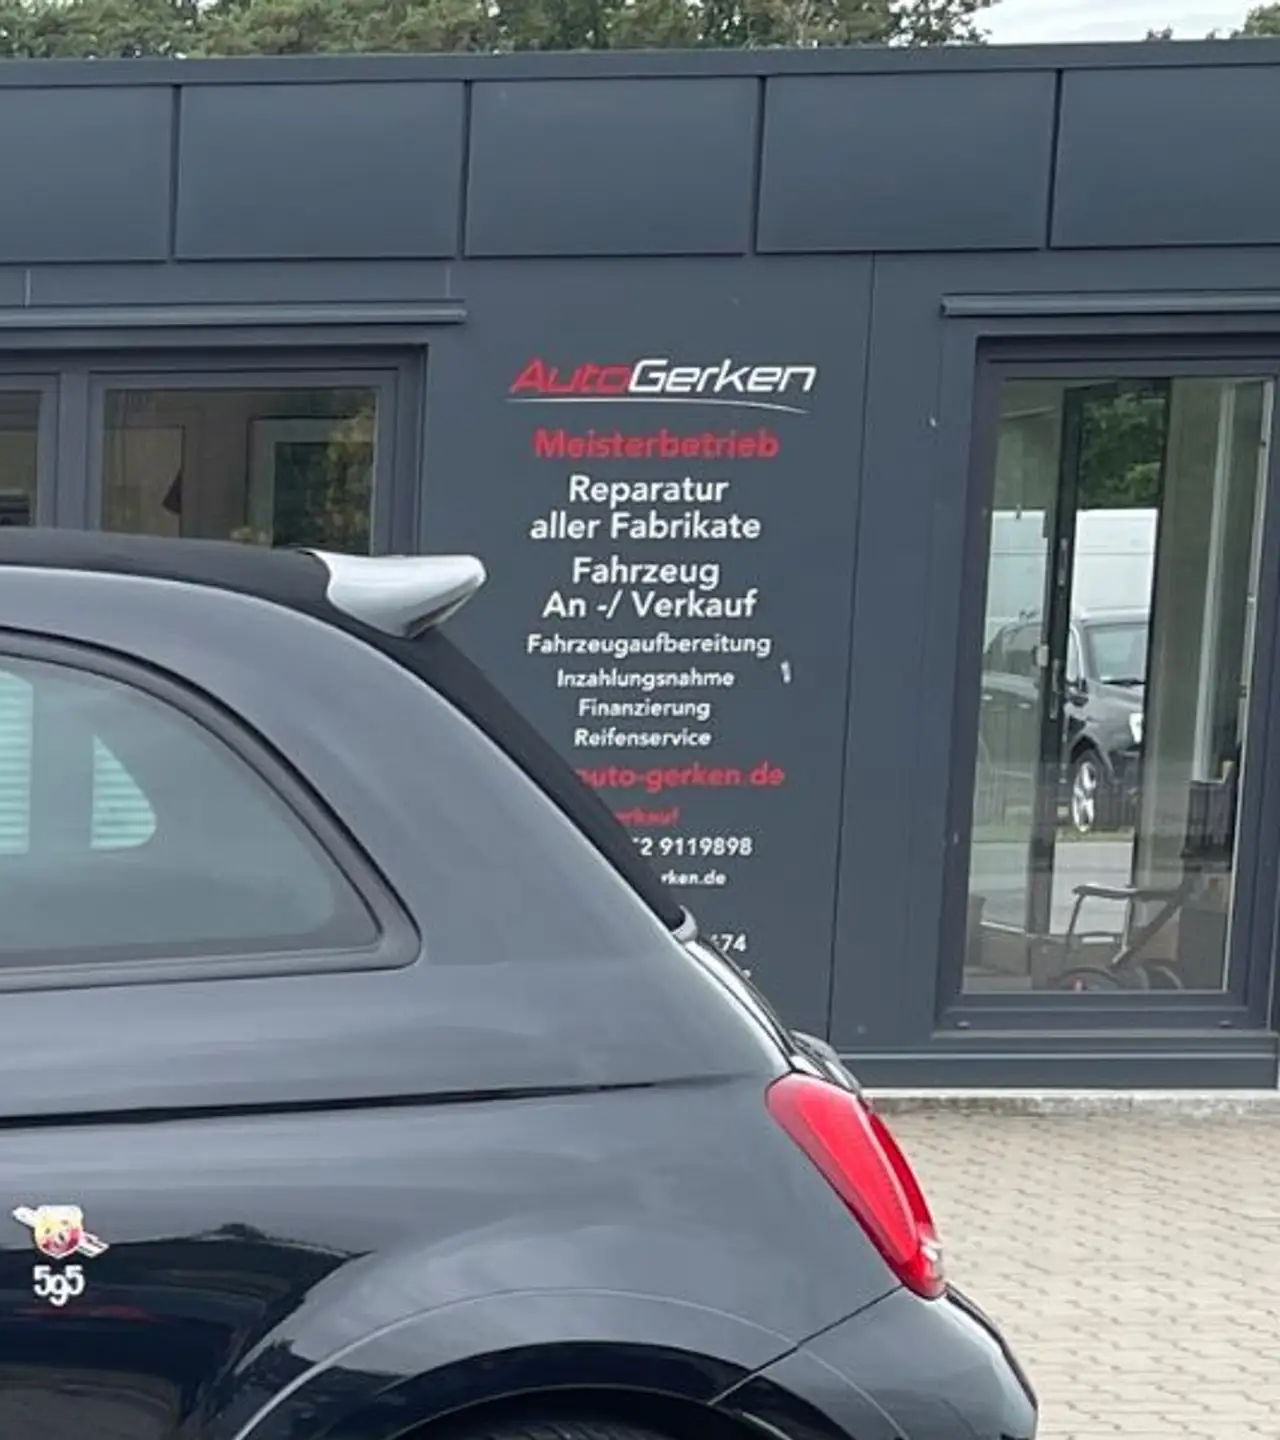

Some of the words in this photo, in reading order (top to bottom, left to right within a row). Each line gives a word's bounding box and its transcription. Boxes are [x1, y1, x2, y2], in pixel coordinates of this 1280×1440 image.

[509, 358, 818, 393] AutoGerken
[532, 428, 779, 458] Meisterbetrieb
[568, 474, 729, 509] Reparatur
[530, 509, 601, 539] aller
[610, 509, 762, 539] Fabrikate
[572, 554, 720, 591] Fahrzeug
[542, 590, 586, 618] An
[630, 588, 758, 618] Verkauf
[527, 632, 772, 659] Fahrzeugaufbereitung
[557, 667, 735, 691] Inzahlungsnahme
[578, 697, 711, 721] Finanzierung
[574, 726, 712, 747] Reifenservice
[632, 836, 653, 856] 2
[659, 836, 754, 856] 9119898
[33, 1264, 85, 1307] 595
